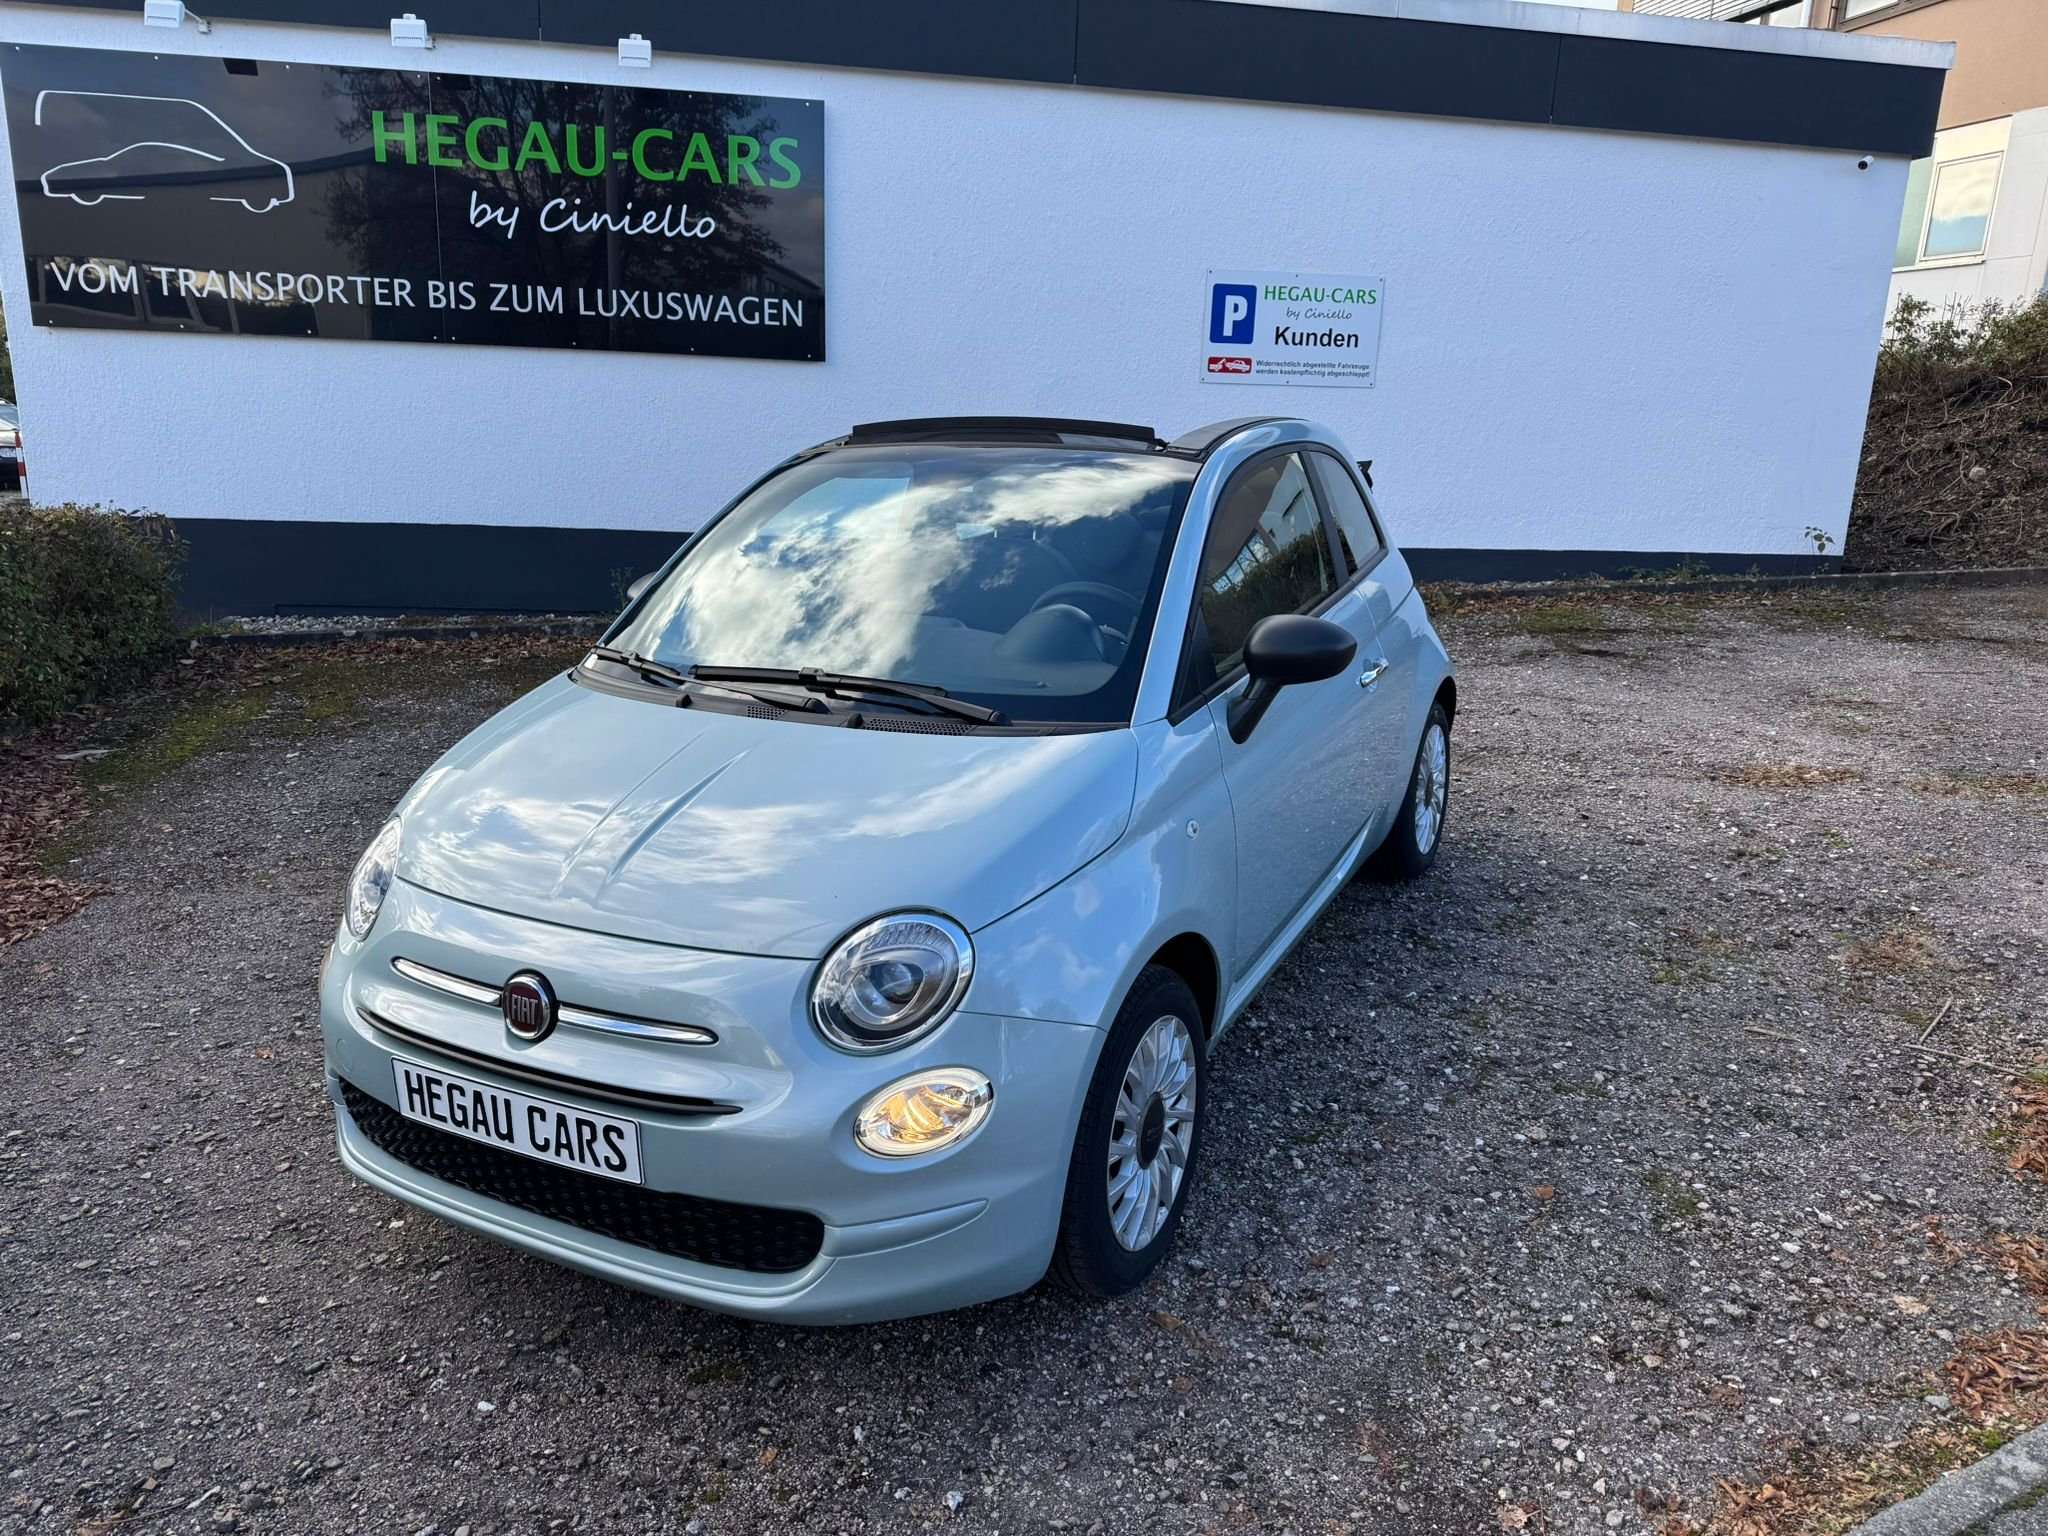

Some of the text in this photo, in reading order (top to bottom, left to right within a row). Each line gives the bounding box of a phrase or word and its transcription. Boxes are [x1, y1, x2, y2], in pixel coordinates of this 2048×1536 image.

[371, 110, 801, 189] HEGAU-CARS
[468, 190, 716, 239] by Ciniello
[50, 262, 804, 328] VOM TRANSPORTER BIS ZUM LUXUSWAGEN
[1223, 294, 1249, 337] P
[1264, 285, 1377, 305] HEGAU-CARS
[1286, 307, 1353, 320] by Ciniello
[1274, 325, 1359, 348] Kunden
[511, 995, 538, 1025] FIAT
[404, 1069, 627, 1173] HEGAU CARS
